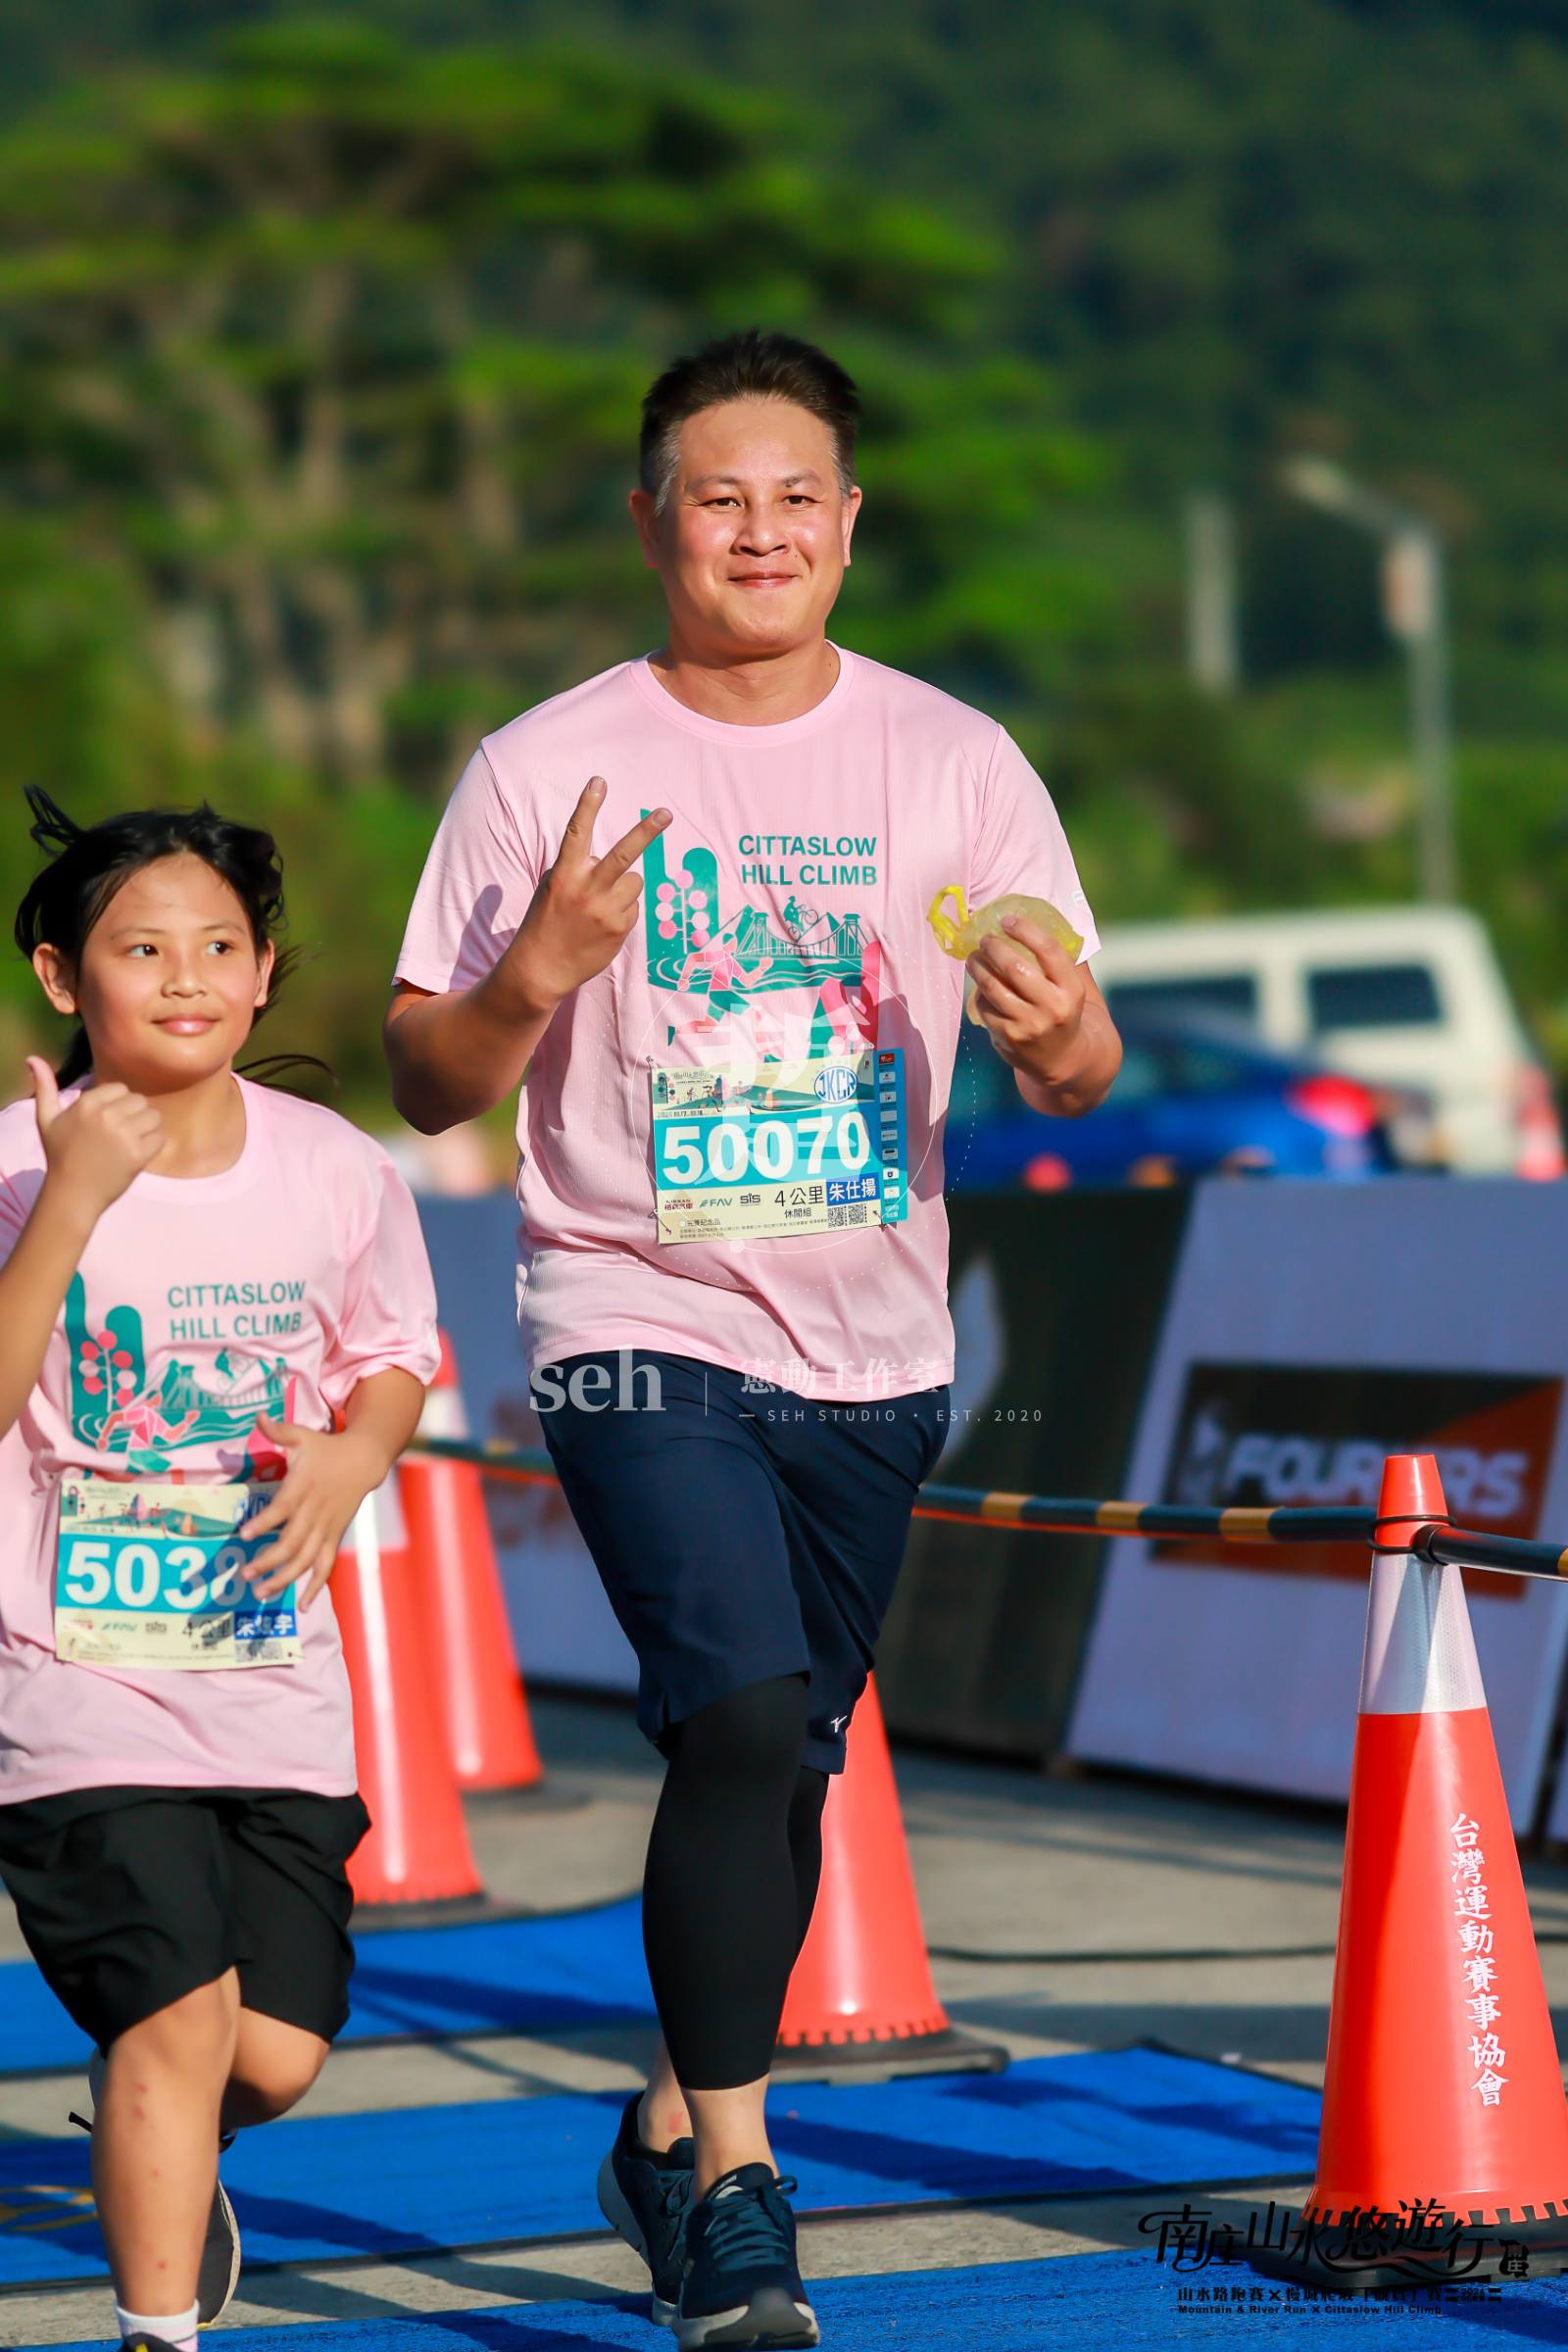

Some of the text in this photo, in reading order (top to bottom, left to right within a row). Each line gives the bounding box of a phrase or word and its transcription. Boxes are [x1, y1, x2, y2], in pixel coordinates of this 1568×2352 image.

[738, 834, 877, 858] CITTASLOW
[742, 864, 877, 886] HILL CLIMB
[662, 1111, 871, 1186] 50070
[828, 1178, 877, 1201] 朱仕揚
[168, 1280, 306, 1308] CITTASLOW
[170, 1311, 303, 1341] HILL CLIMB
[1449, 1813, 1509, 2106] 台灣運動賽事協會
